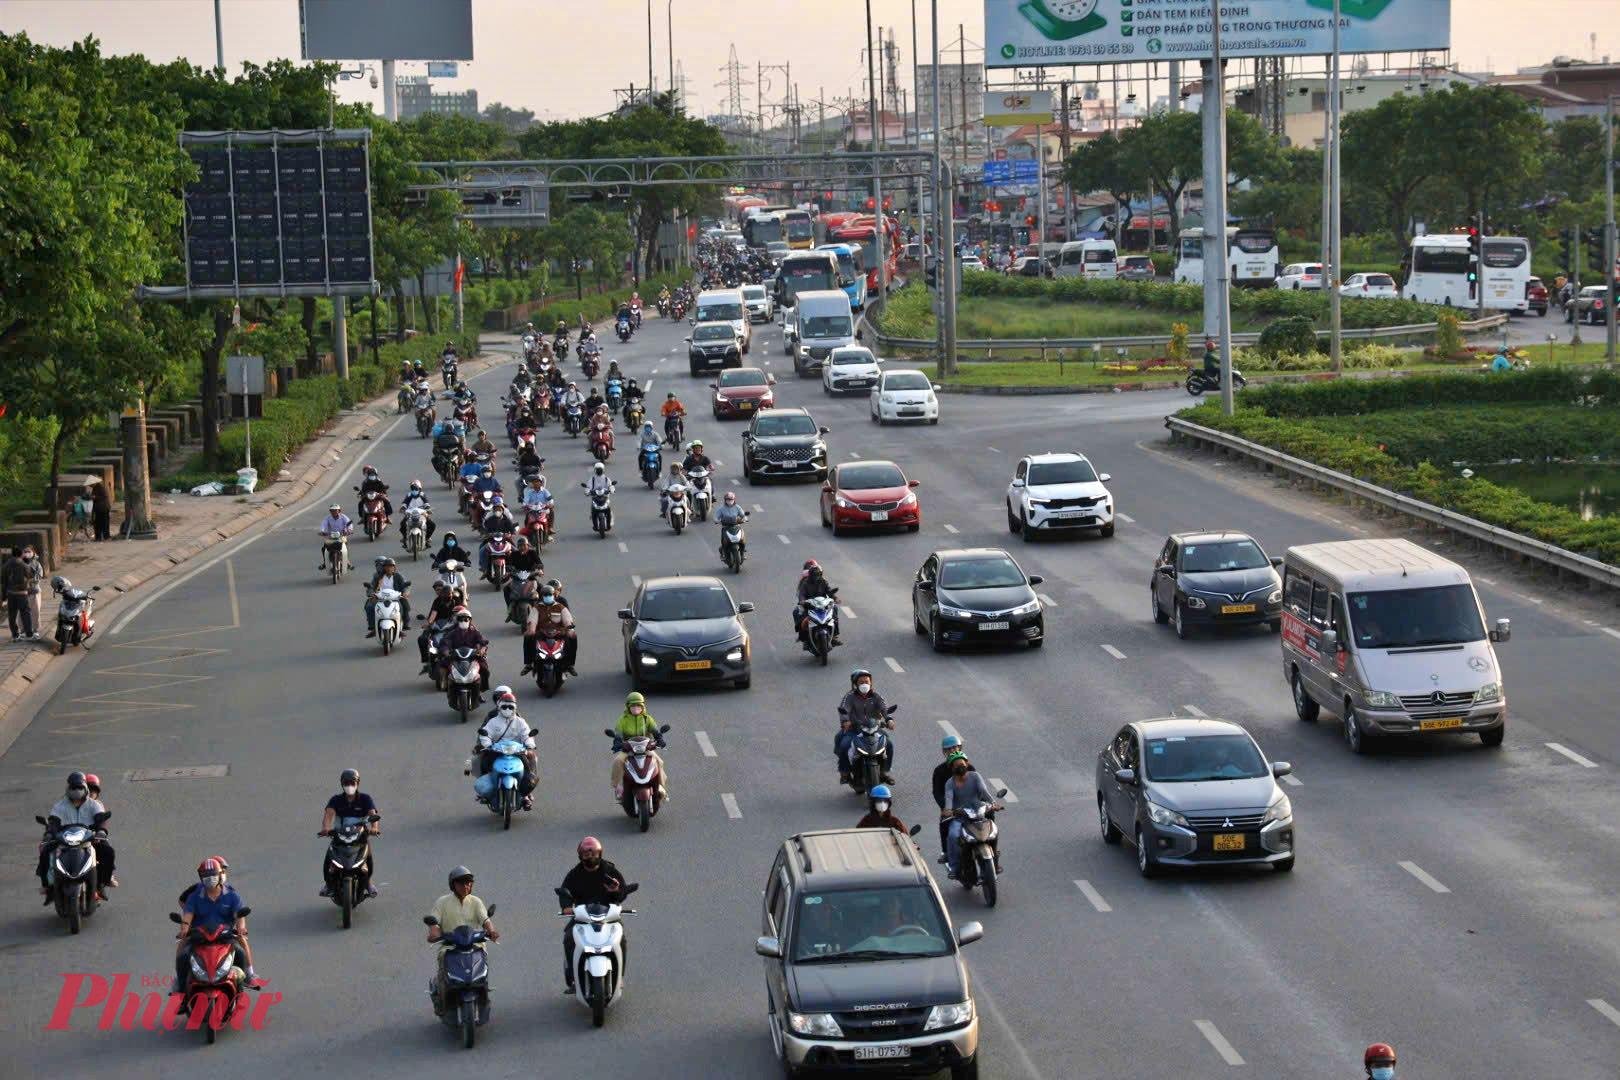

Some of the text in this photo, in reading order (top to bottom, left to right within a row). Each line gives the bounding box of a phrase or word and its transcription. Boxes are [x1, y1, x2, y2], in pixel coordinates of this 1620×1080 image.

[1164, 9, 1186, 18] TEM
[1220, 7, 1248, 18] ĐỊNH
[1137, 25, 1160, 36] HỢP
[1164, 22, 1193, 34] PHÁP
[1197, 22, 1229, 33] DÙG
[1233, 21, 1271, 32] TRONG
[1273, 19, 1325, 30] THƯƠNG
[1017, 45, 1066, 57] HOTLINE:
[1068, 44, 1092, 55] 0934
[1093, 44, 1106, 55] 39
[1107, 43, 1120, 54] 55
[854, 1002, 909, 1011] DISCOVERY
[871, 1019, 896, 1027] ISUZU
